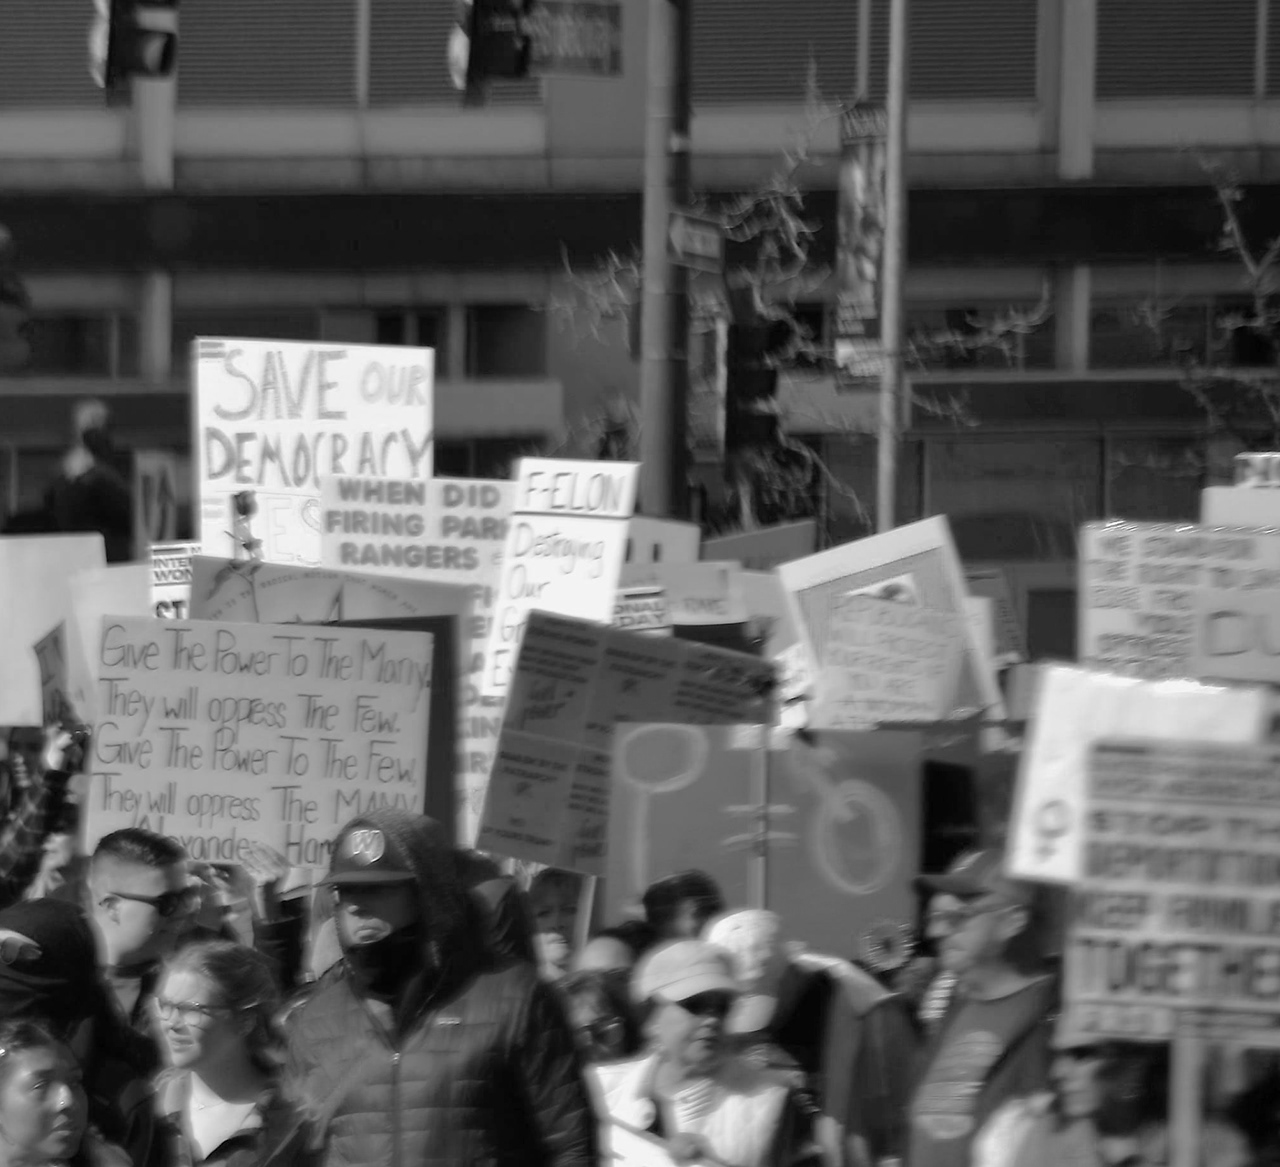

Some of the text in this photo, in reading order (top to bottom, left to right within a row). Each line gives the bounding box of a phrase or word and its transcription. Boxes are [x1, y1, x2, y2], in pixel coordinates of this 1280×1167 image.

[212, 347, 427, 421] SAVE OUR
[204, 427, 434, 489] DEMOCRACY
[339, 480, 501, 508] WHEN DID
[325, 511, 426, 539] FIRING
[340, 541, 477, 571] RANGERS
[100, 622, 355, 682] Give The Power To The
[97, 676, 154, 737] They
[161, 685, 200, 723] will
[297, 693, 341, 734] The
[93, 721, 154, 771] Give
[158, 726, 204, 770] The
[212, 727, 279, 774] Power
[279, 734, 310, 778] To
[318, 737, 359, 781] The
[92, 771, 144, 815] They
[147, 781, 179, 817] will
[186, 789, 262, 829] oppress
[270, 784, 319, 826] The
